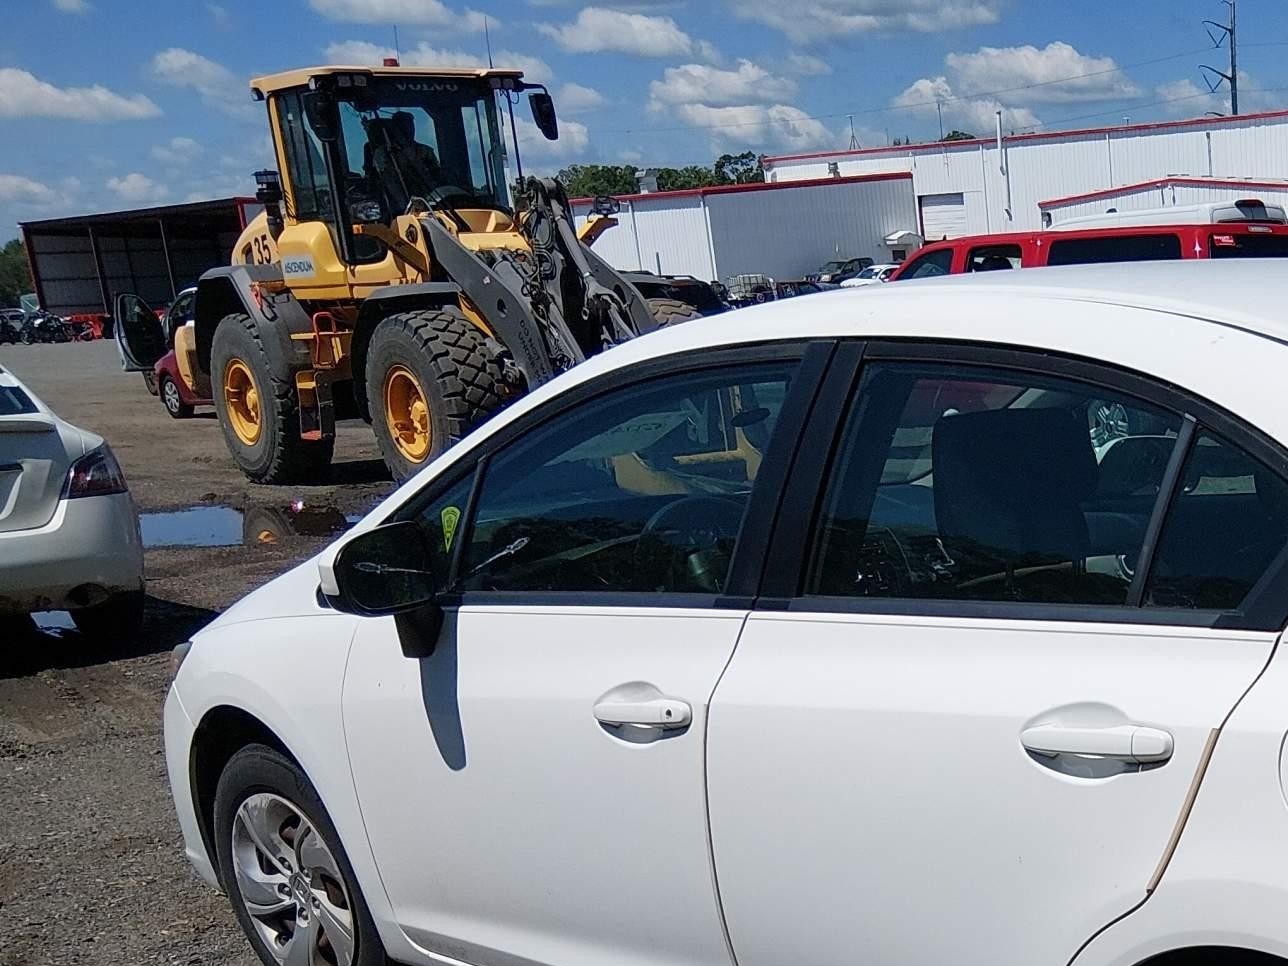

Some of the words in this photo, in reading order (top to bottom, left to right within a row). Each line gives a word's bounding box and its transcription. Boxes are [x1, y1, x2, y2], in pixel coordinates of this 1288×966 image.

[395, 82, 459, 92] VOLVO
[253, 233, 272, 265] 35
[284, 260, 314, 274] ASCENDUM
